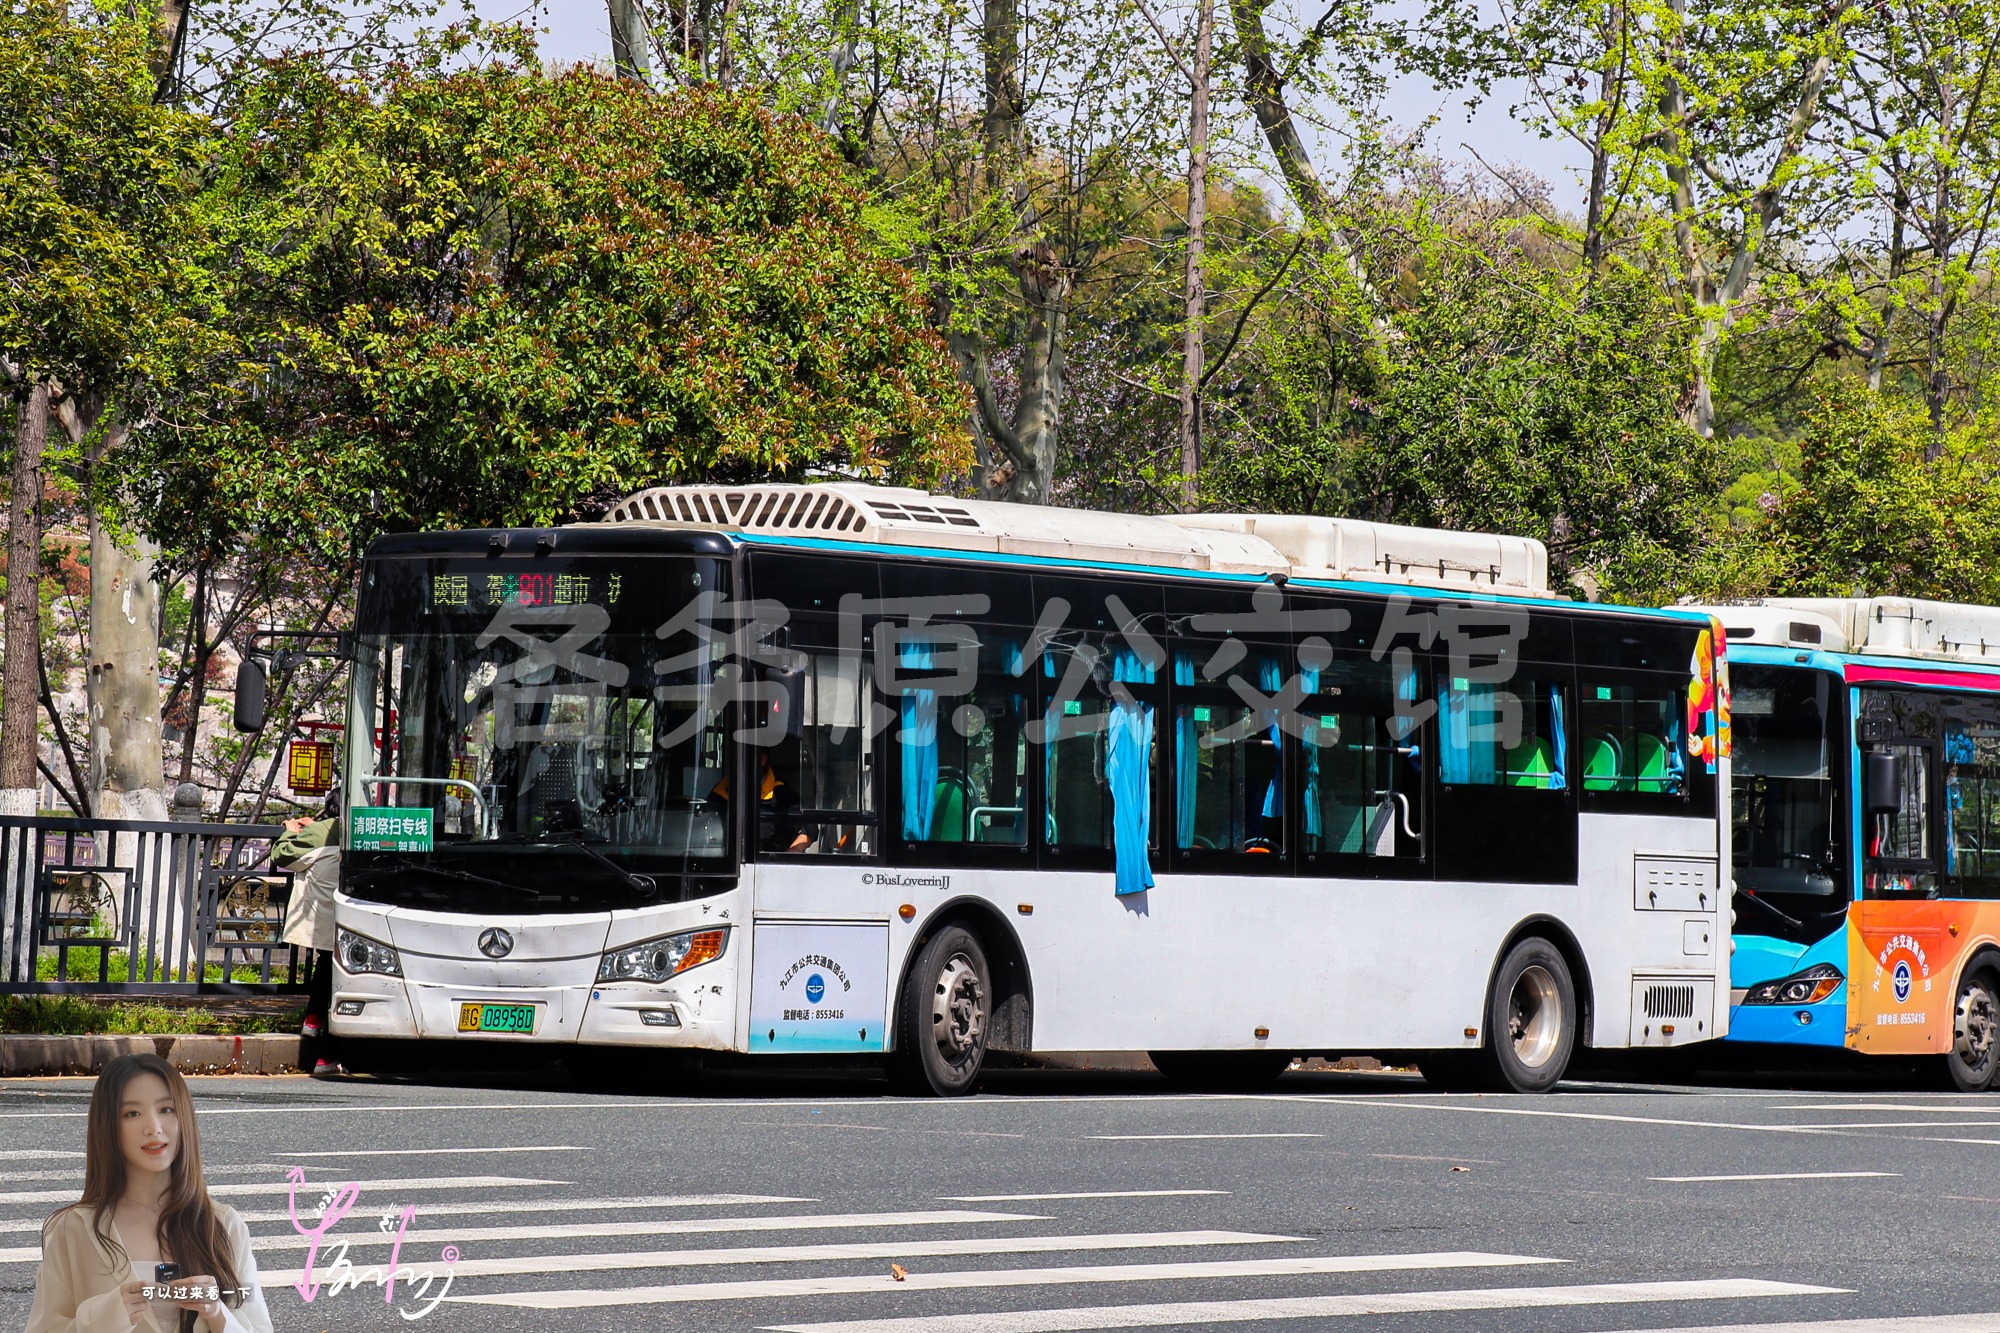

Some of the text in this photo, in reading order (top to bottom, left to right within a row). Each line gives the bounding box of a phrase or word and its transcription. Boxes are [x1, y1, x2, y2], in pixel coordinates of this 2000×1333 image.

[518, 573, 554, 606] 801
[554, 574, 591, 606] 超市
[353, 816, 428, 836] 清明祭扫专线
[779, 954, 851, 992] 九江市公共交通集团公司
[1872, 934, 1932, 993] 九江市公共交通集团公司
